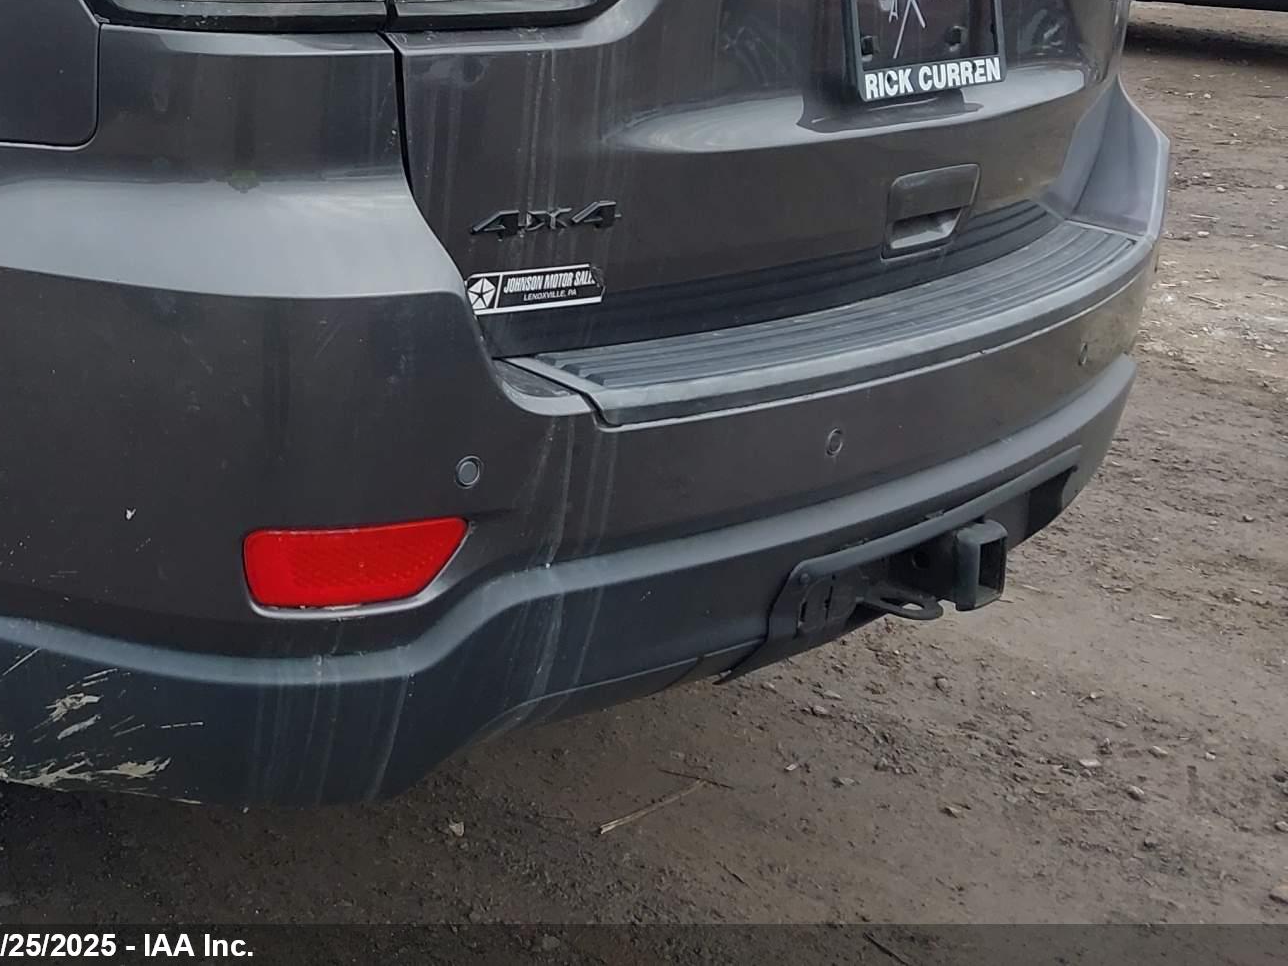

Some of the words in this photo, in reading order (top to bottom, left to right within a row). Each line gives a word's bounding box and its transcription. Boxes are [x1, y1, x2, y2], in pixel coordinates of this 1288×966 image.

[865, 67, 914, 100] RICK
[918, 56, 1002, 91] CURREN
[503, 275, 544, 294] JOHNSON
[544, 272, 574, 290] MOTOR
[567, 288, 577, 296] PA
